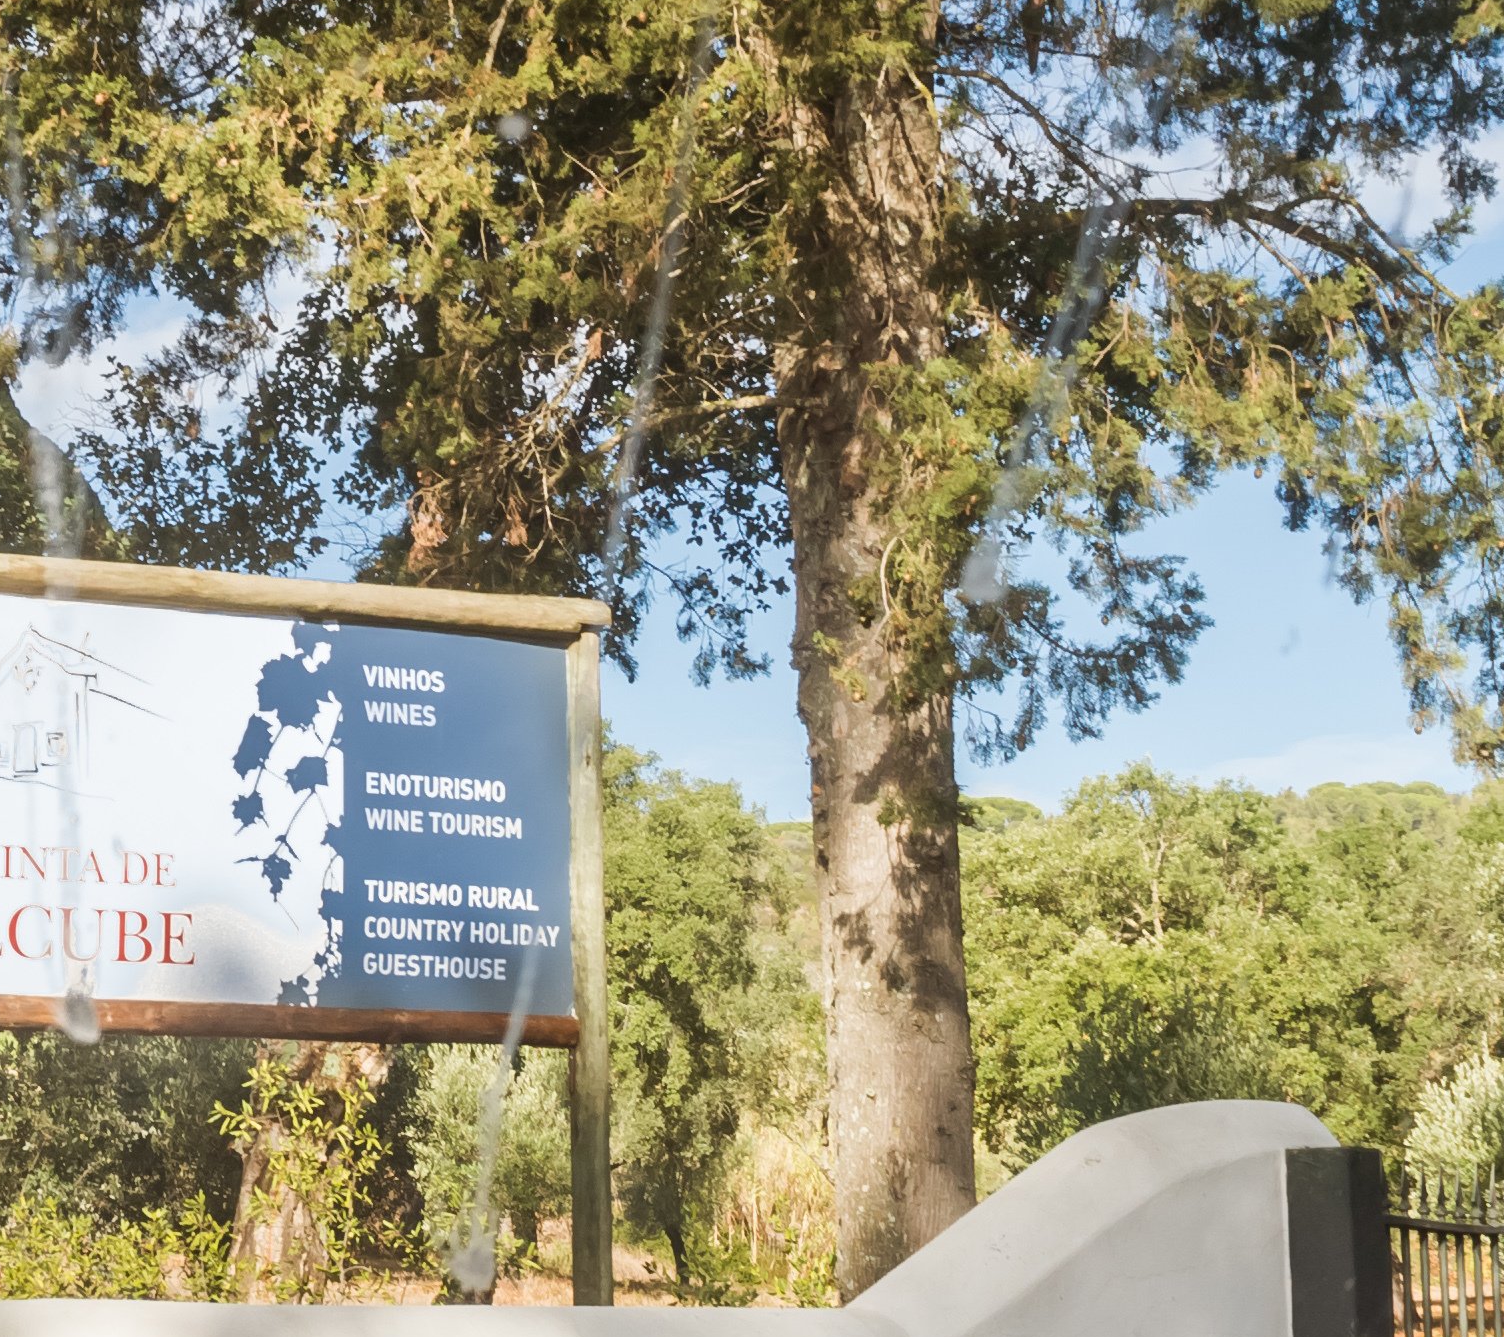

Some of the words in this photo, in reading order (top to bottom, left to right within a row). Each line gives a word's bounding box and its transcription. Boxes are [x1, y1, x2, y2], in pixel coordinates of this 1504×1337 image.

[363, 664, 446, 693] VINHOS
[364, 701, 437, 727] WINES
[366, 771, 506, 803] ENOTURISMO
[365, 808, 424, 833] WINE
[429, 812, 523, 840] TOURISM
[119, 851, 177, 887] DE
[365, 879, 463, 907] TURISMO
[468, 885, 540, 912] RURAL
[364, 916, 465, 942] COUNTRY
[470, 921, 561, 948] HOLIDAY
[363, 953, 507, 980] GUESTHOUSE
